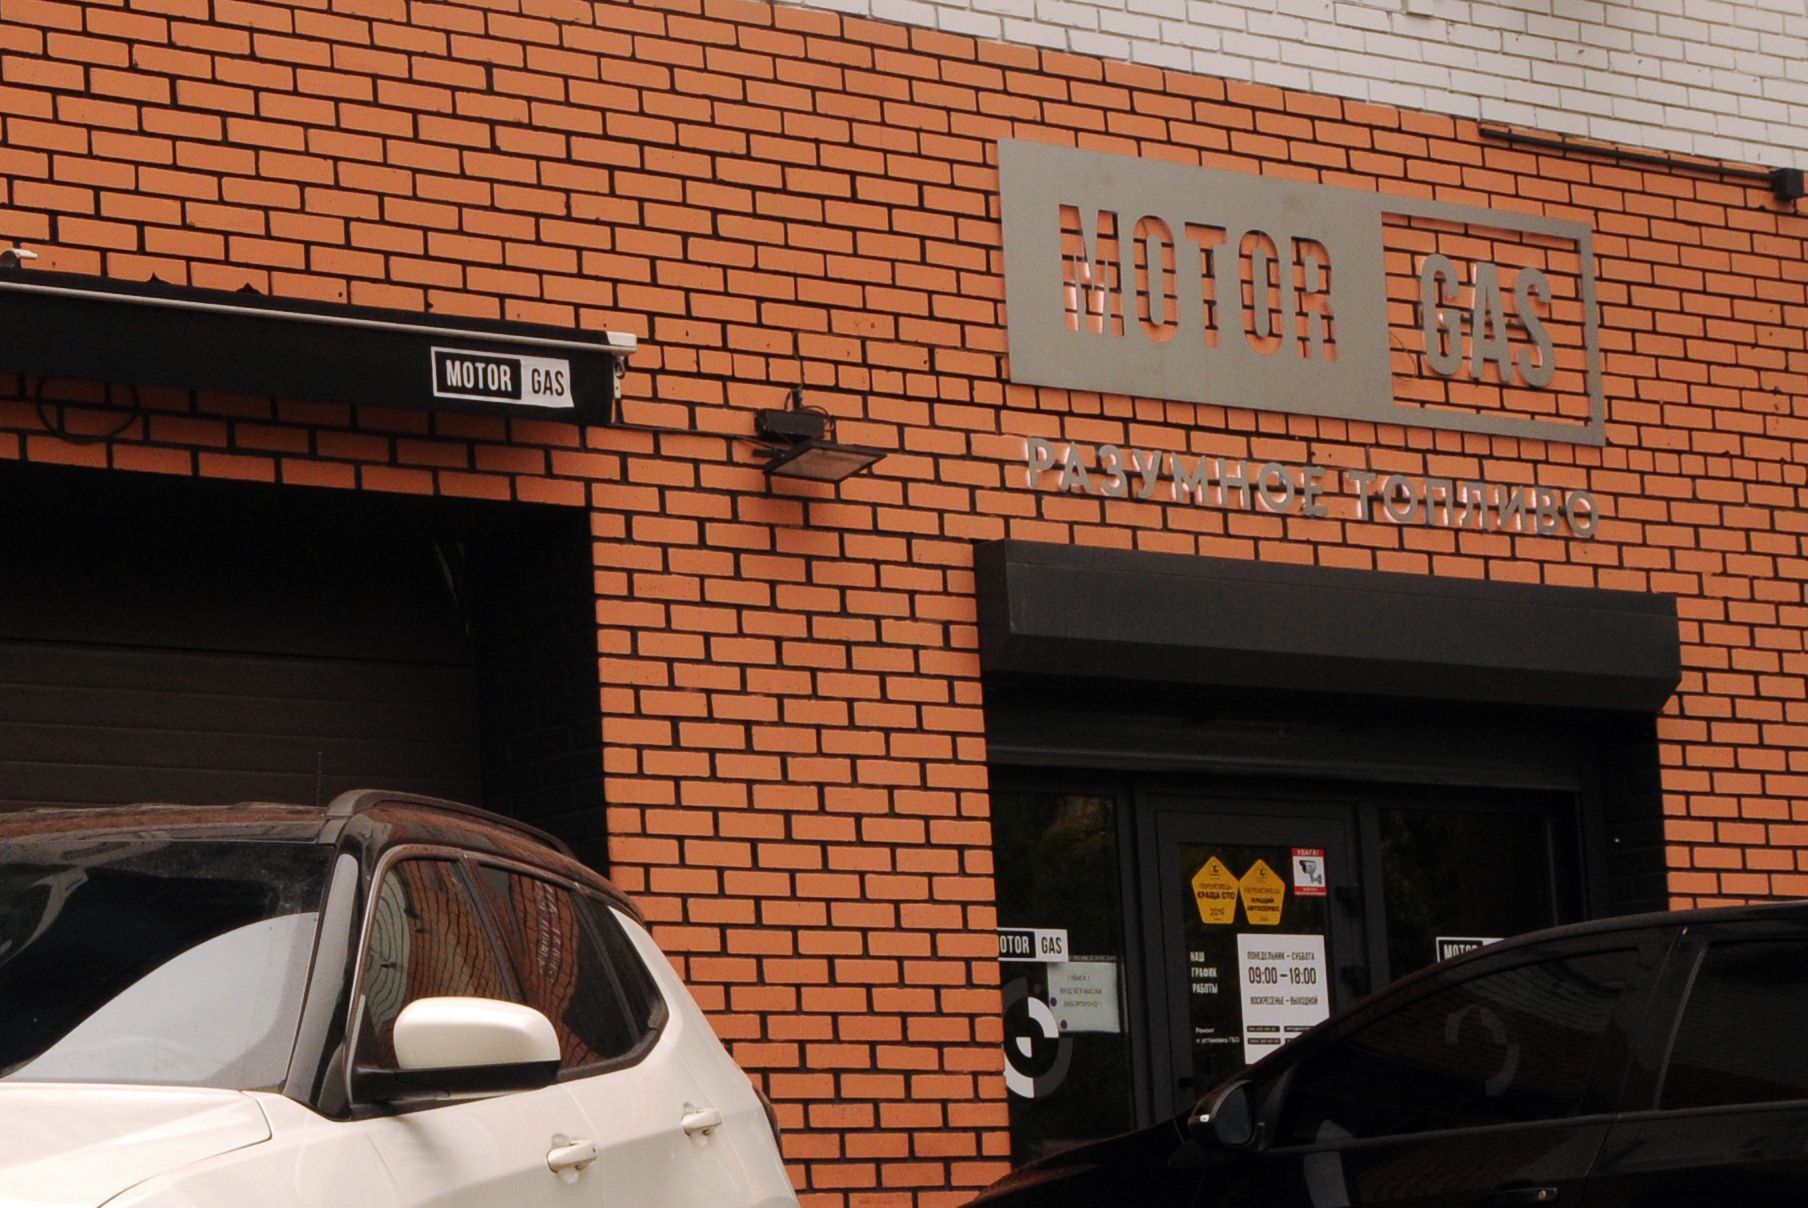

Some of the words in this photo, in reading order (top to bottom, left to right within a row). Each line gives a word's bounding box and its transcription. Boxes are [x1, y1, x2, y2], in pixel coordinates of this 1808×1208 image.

[1058, 204, 1342, 361] MOTOR
[1420, 254, 1556, 388] GAS
[445, 360, 512, 392] MOTOR
[531, 368, 565, 396] GAS
[1024, 436, 1329, 518] РАЗУМНОЕ
[1346, 470, 1599, 538] ТОПЛИВО
[999, 935, 1030, 954] OTOR
[1041, 937, 1062, 954] GAS
[1291, 952, 1315, 961] СУББОТА
[1191, 967, 1218, 978] ГРАФИК
[1248, 966, 1278, 984] 09:00
[1289, 967, 1317, 985] 18:00
[1192, 983, 1219, 994] РАБОТЫ
